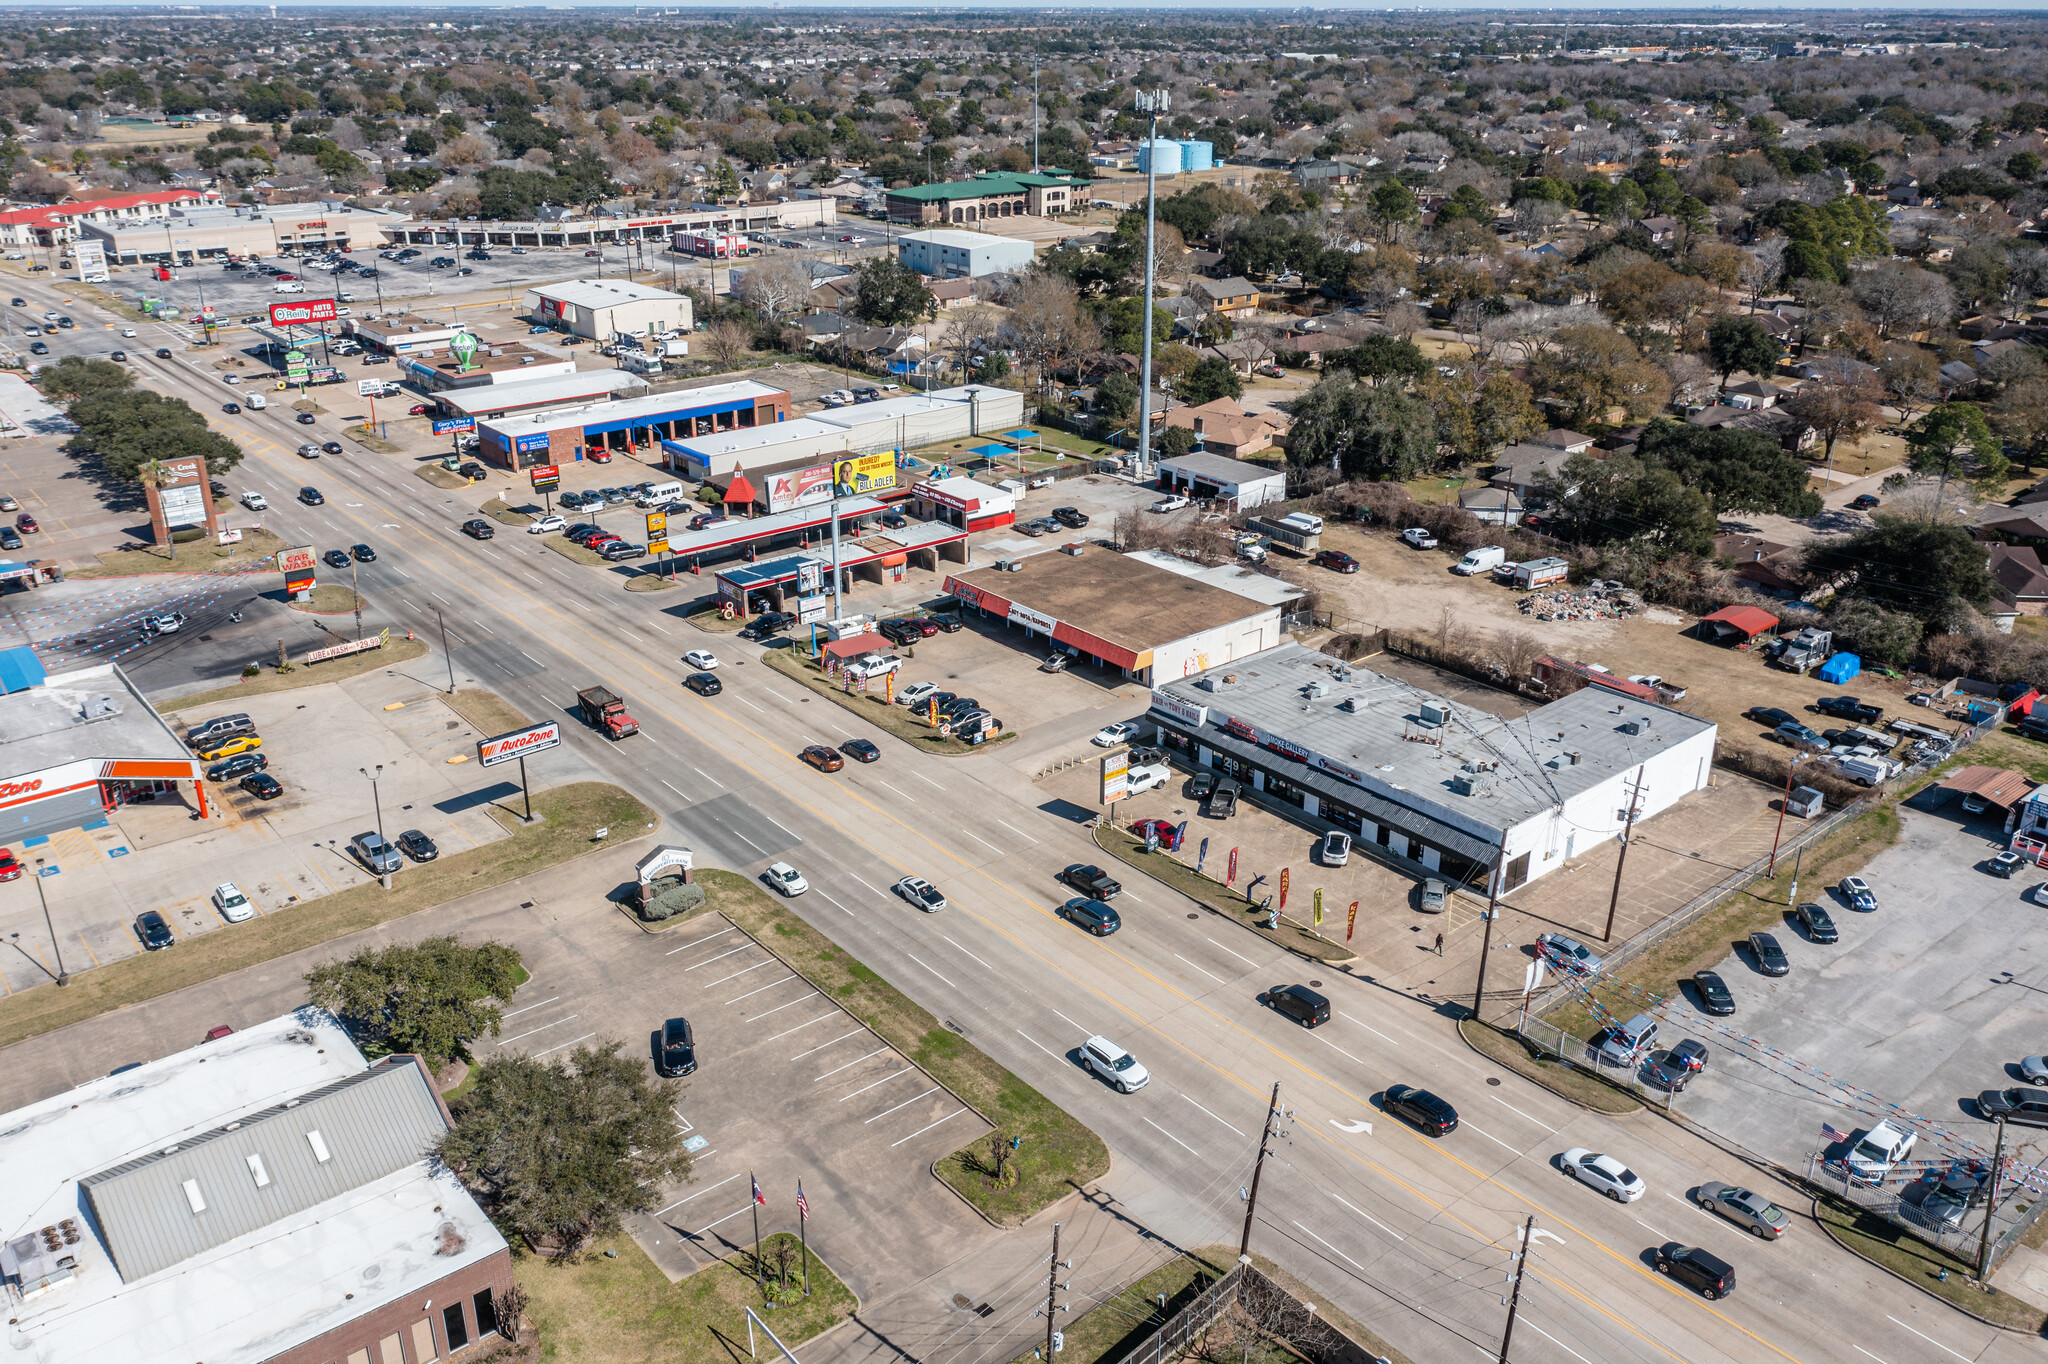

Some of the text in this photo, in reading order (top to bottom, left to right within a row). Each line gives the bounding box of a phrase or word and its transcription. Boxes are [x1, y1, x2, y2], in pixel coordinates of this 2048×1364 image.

[275, 303, 331, 321] O'Reilly AUTO
[312, 310, 334, 319] PARTS
[177, 463, 197, 471] Creek
[859, 455, 880, 466] INJURED?
[860, 475, 894, 490] BILL ADLER
[772, 493, 794, 501] Amtex
[282, 560, 316, 571] WASH
[286, 553, 309, 563] CAR
[309, 651, 327, 661] LUBE
[330, 645, 349, 656] WASH
[1168, 702, 1181, 714] TONY
[1186, 710, 1200, 722] NAILS
[500, 729, 554, 753] AutoZone
[1266, 734, 1309, 758] SMOKE GALLERY
[646, 859, 674, 878] PROSPERITY
